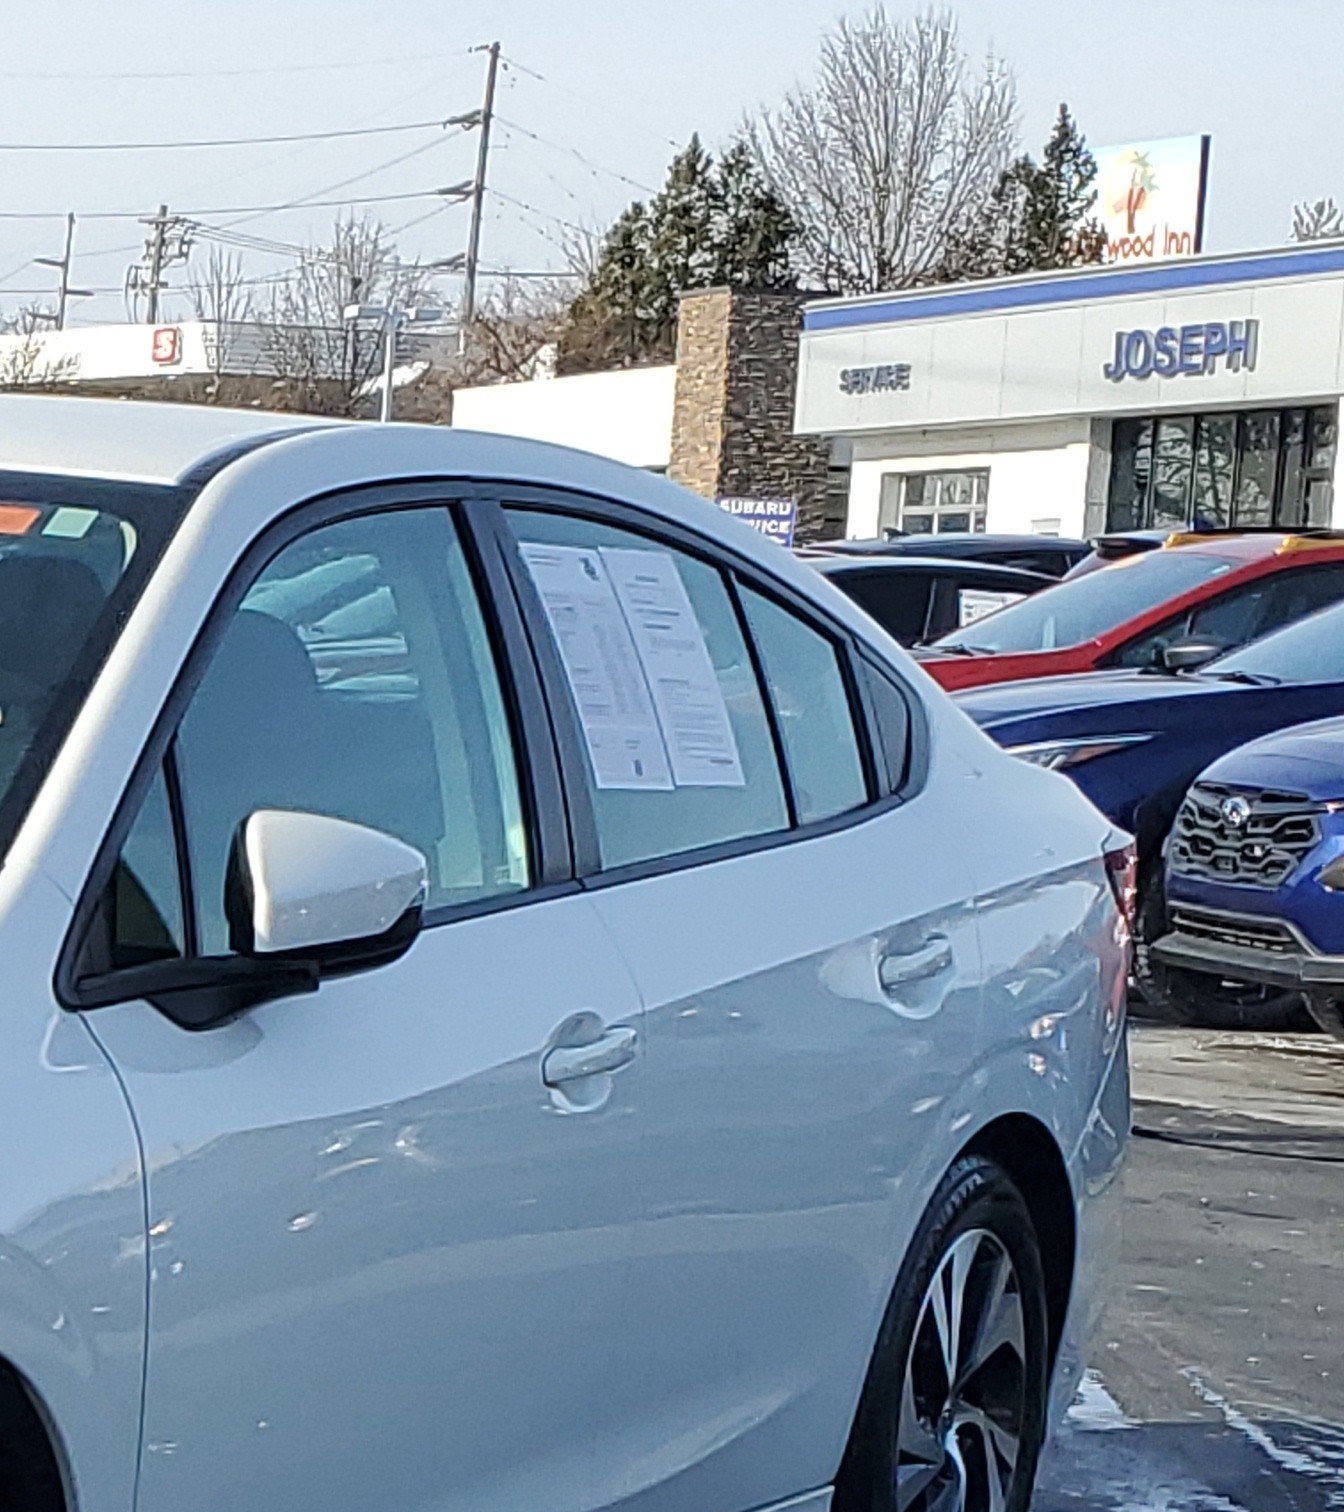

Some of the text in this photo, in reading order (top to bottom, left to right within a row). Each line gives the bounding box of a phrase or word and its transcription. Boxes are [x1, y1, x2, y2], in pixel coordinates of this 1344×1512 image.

[1163, 224, 1192, 256] Inn
[1105, 319, 1259, 382] JOSEPH
[720, 500, 791, 516] SUBARU
